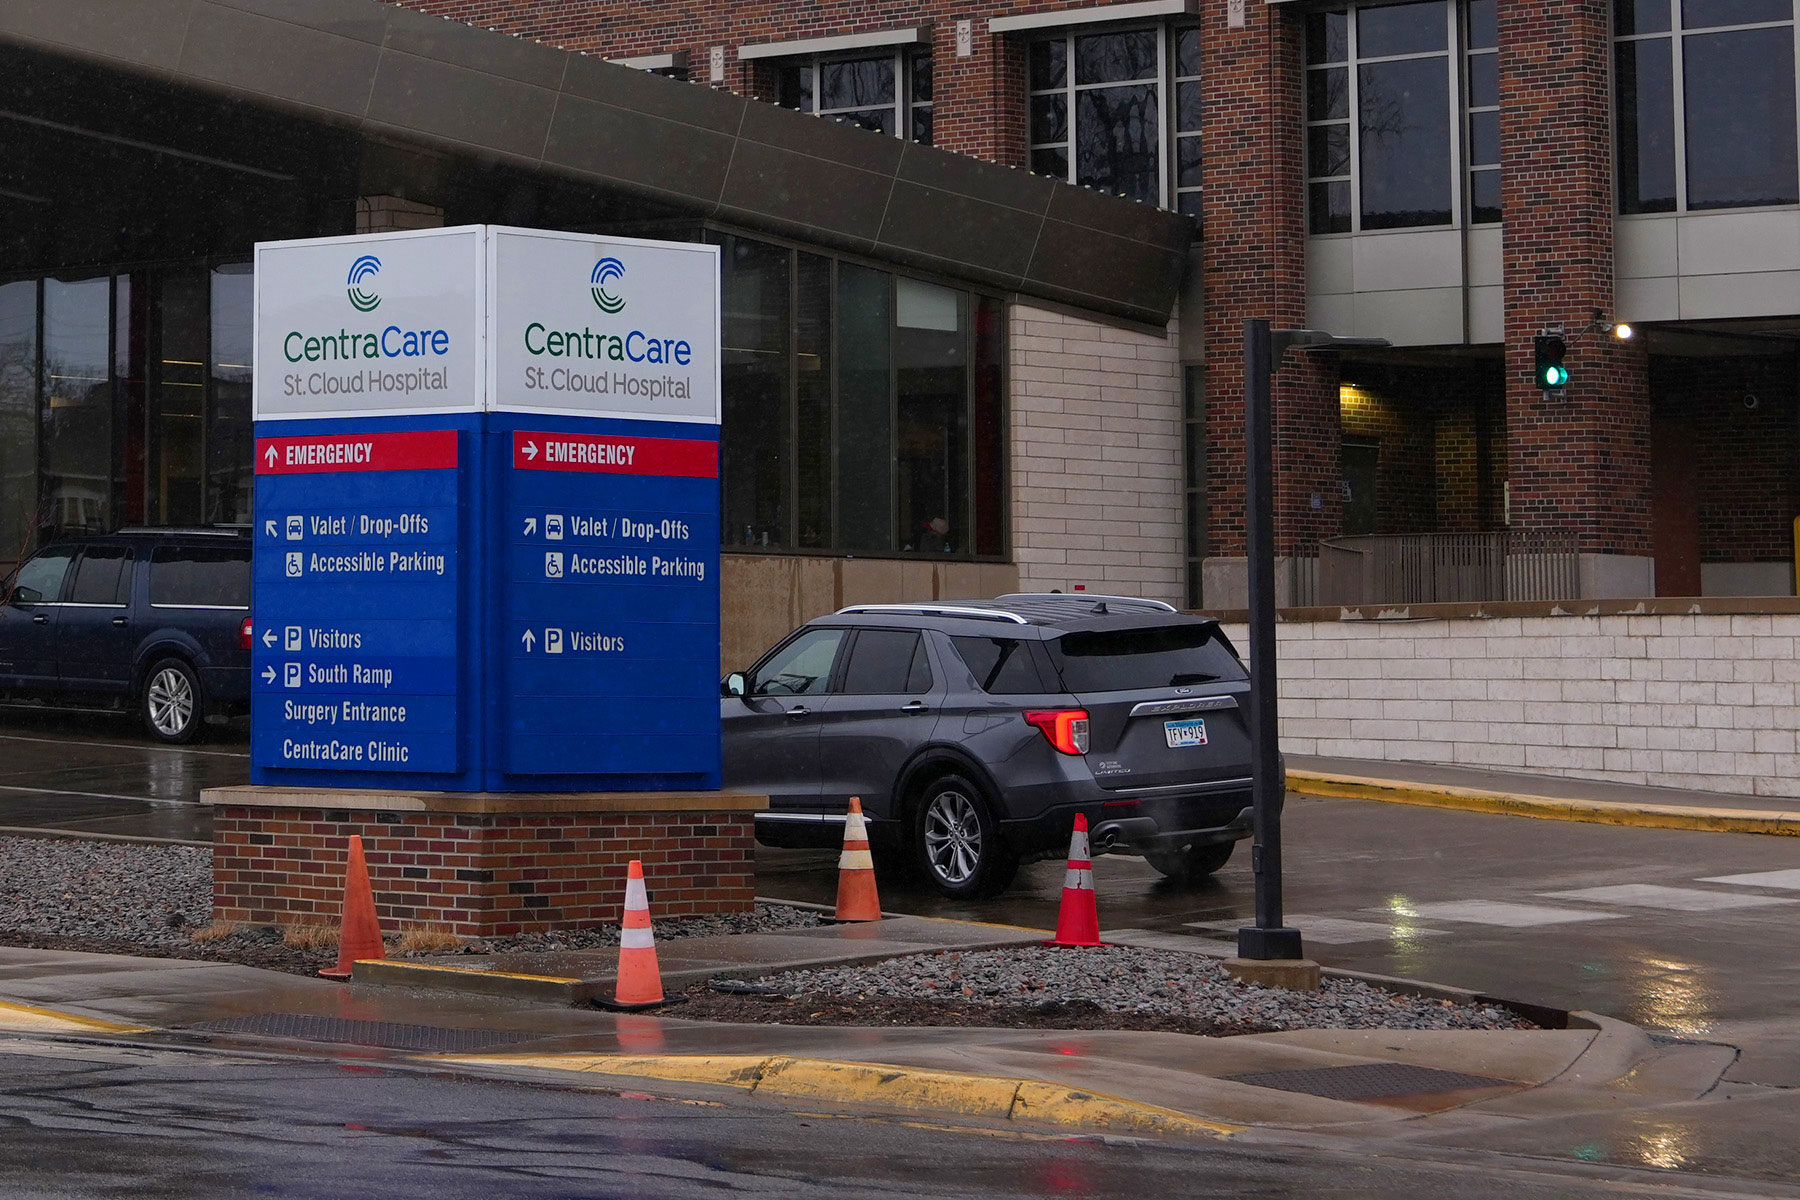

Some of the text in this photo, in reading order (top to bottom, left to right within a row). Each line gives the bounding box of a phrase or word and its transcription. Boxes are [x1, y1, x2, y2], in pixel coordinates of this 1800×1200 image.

[283, 325, 449, 363] CentraCare
[524, 322, 692, 366] CentraCare
[308, 370, 364, 395] Cloud
[368, 366, 448, 395] Hospital
[551, 368, 609, 394] Cloud
[613, 372, 691, 401] Hospital
[285, 442, 373, 465] EMERGENCY
[545, 441, 636, 465] EMERGENCY
[310, 515, 346, 536] Valet
[360, 513, 429, 539] Drop-Offs
[570, 515, 608, 537] Valet
[621, 517, 689, 543] Drop-Offs
[309, 551, 445, 576] Accessible Parking
[570, 553, 705, 582] Accessible Parking
[308, 628, 362, 649] Visitors
[570, 631, 625, 652] Visitors
[308, 662, 348, 684] South
[352, 663, 393, 689] Ramp
[284, 699, 406, 726] Surgery Entrance
[283, 738, 409, 763] CentraCare Clinic
